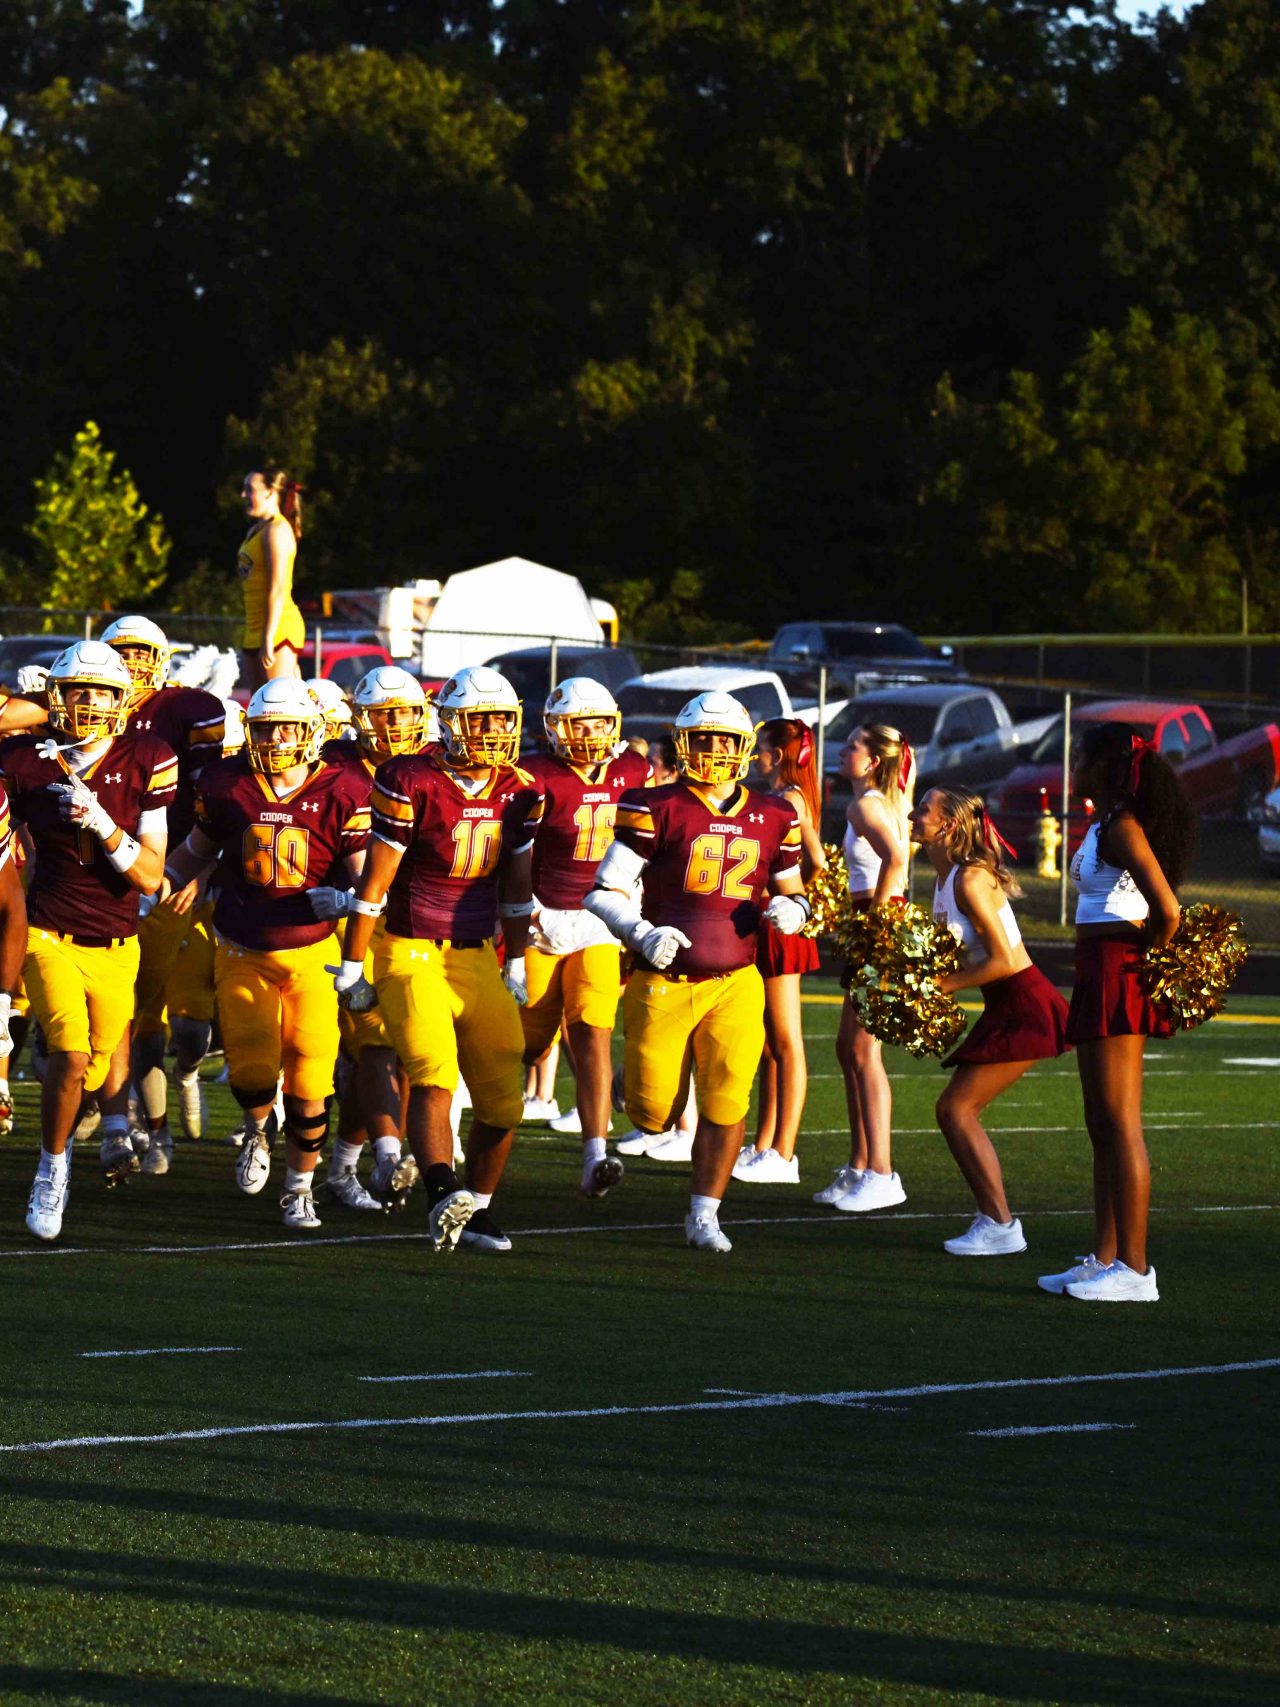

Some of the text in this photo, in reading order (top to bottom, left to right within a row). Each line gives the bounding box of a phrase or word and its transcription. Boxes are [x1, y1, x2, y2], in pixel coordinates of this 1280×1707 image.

[463, 808, 494, 818] COOPER
[583, 792, 611, 802] COOPER
[260, 812, 293, 824] COOPER
[573, 804, 619, 862] 16
[709, 823, 743, 836] COOPER
[243, 824, 310, 888] 60
[449, 820, 503, 879] 10
[683, 833, 761, 900] 62
